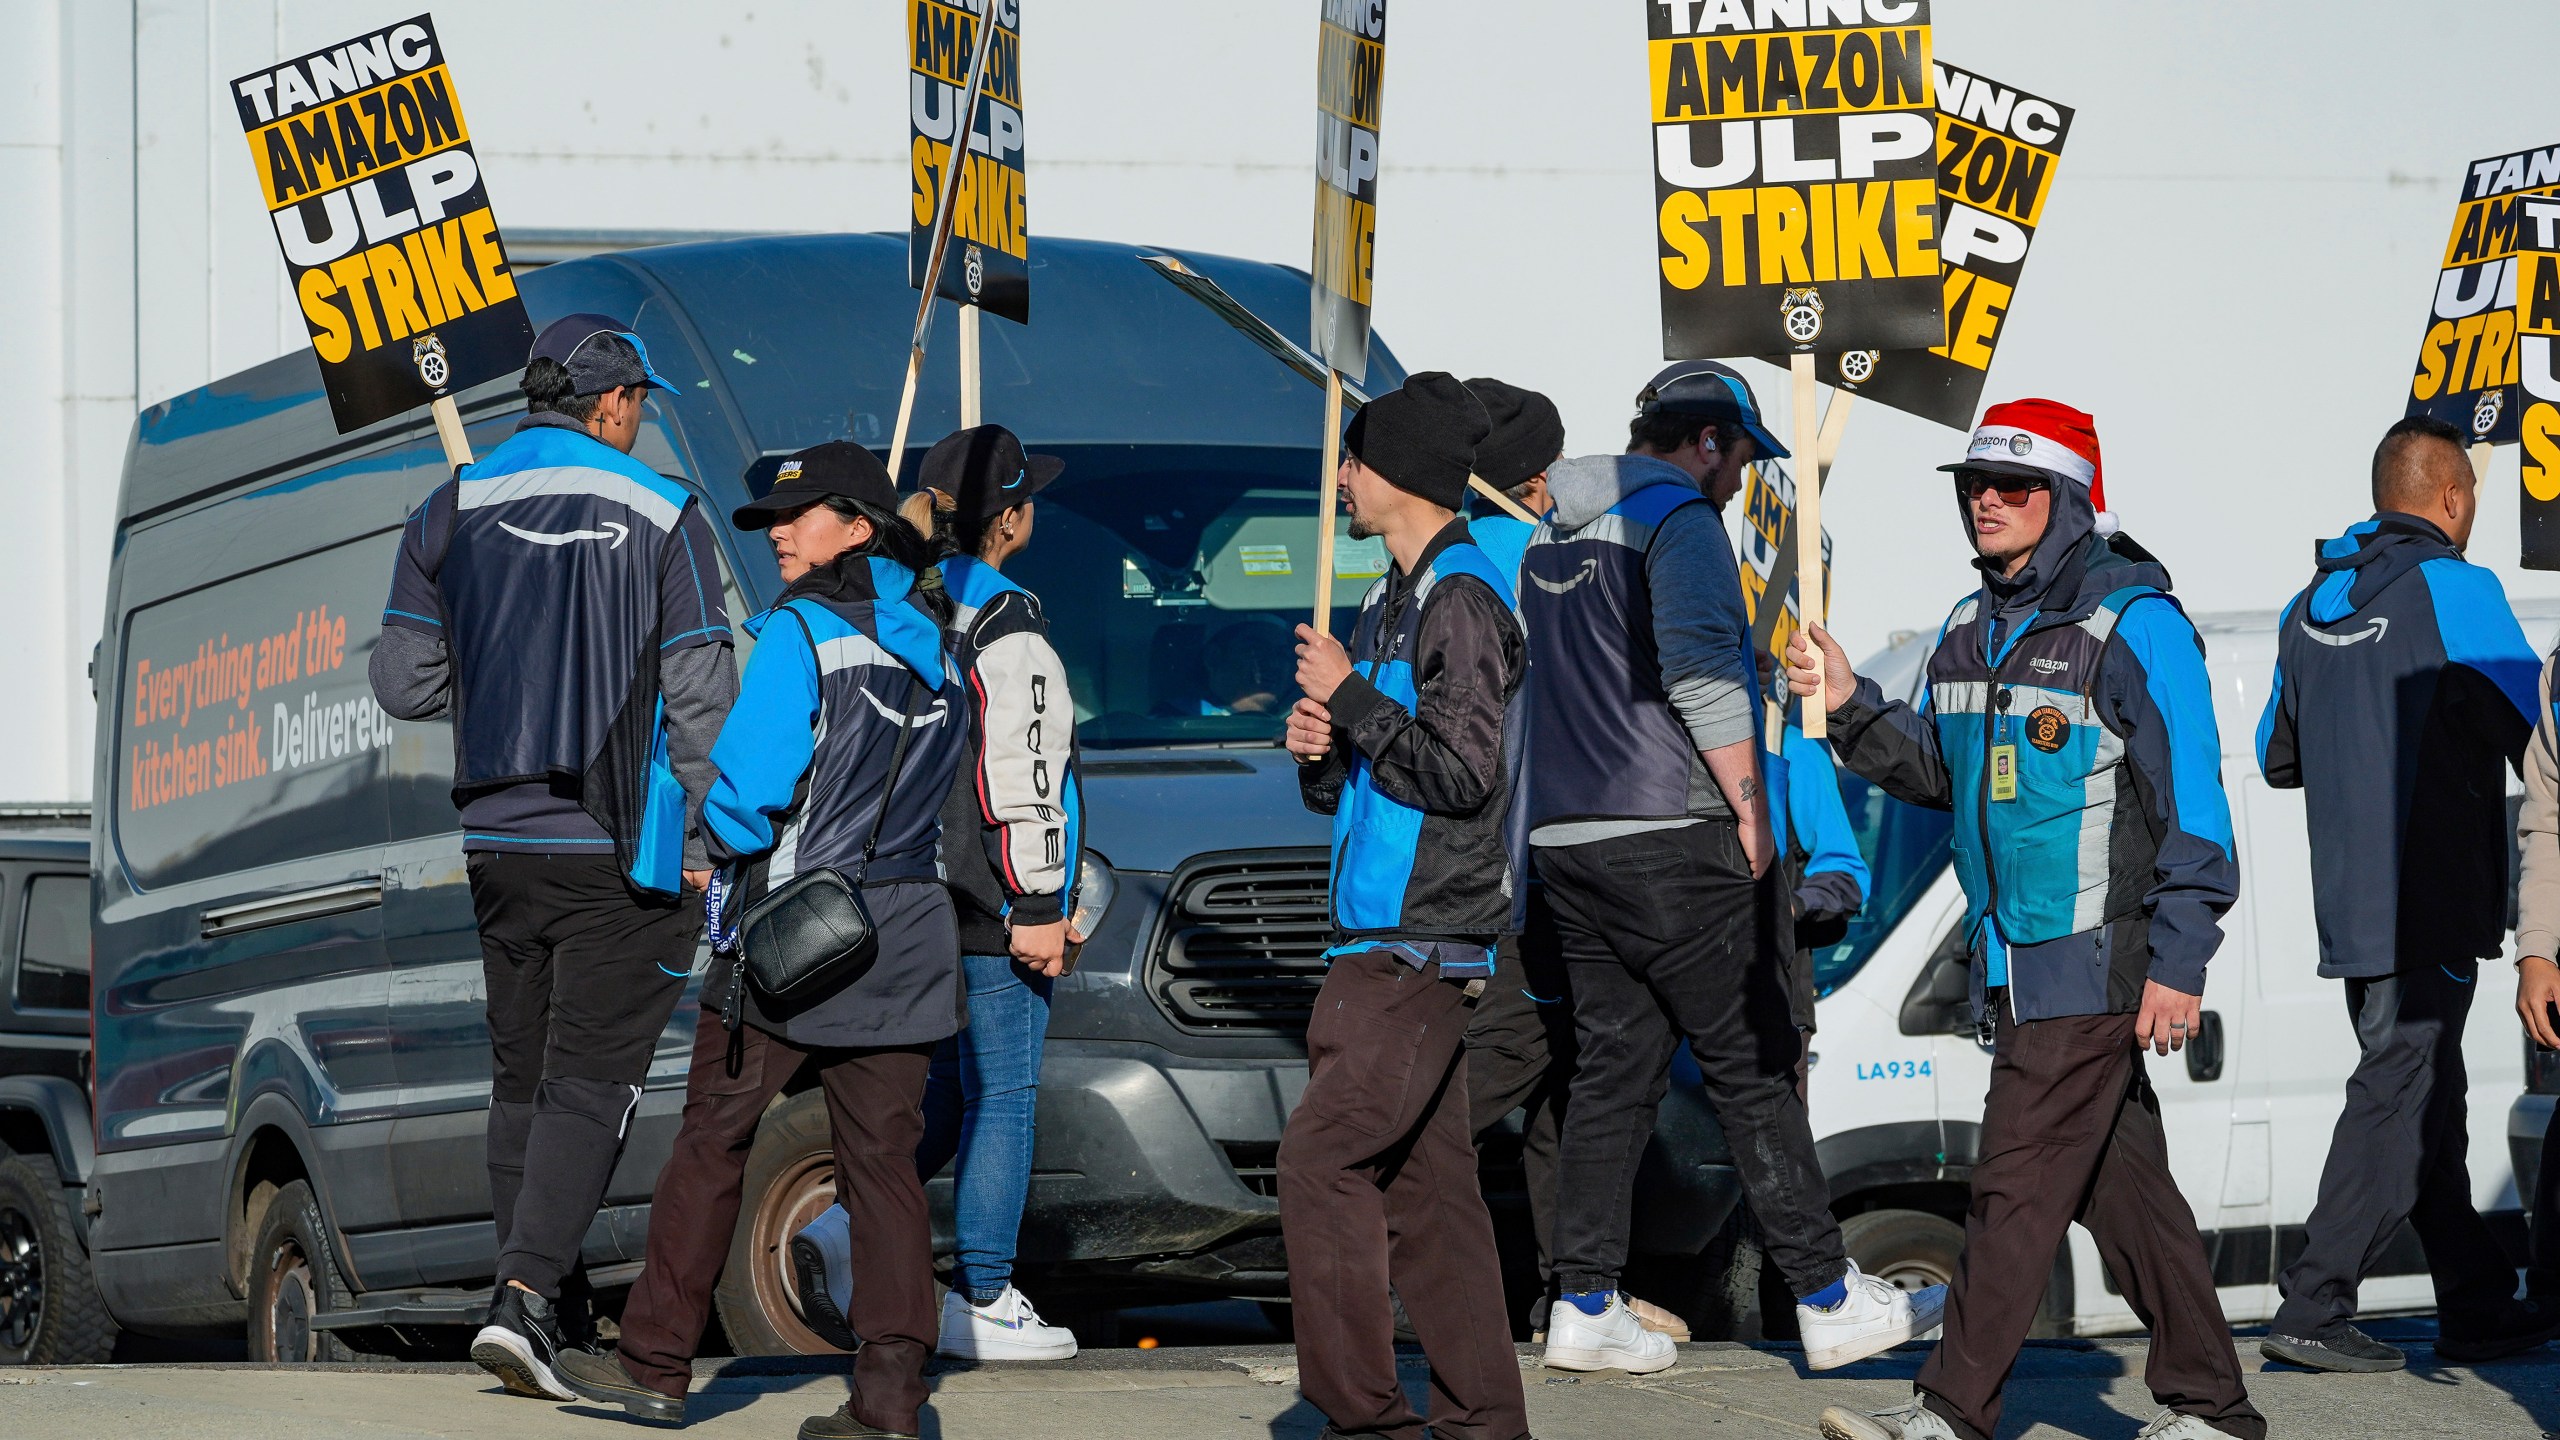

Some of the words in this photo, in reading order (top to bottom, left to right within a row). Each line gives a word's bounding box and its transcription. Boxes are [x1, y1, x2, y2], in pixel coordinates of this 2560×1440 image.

[238, 23, 432, 123] TANNC
[915, 1, 1019, 105] AMAON
[1319, 27, 1382, 127] AMAZON
[1665, 30, 1923, 118] AMAZON
[1933, 64, 2061, 145] NNC
[264, 69, 461, 204] AMAZON
[1316, 110, 1378, 195] ULP
[1656, 112, 1934, 188] ULP
[1936, 118, 2050, 221] ZON
[273, 149, 478, 267] ULP
[912, 135, 1027, 261] STRIKE
[1312, 179, 1376, 308] STRIKE
[1659, 178, 1940, 290] STRIKE
[298, 206, 518, 364] STRIKE
[134, 632, 254, 729] Everything
[256, 610, 303, 691] and
[305, 604, 346, 677] the
[2029, 657, 2069, 673] amazon
[131, 732, 211, 812] kitchen
[214, 709, 267, 789] sink.
[272, 690, 393, 772] Delivered.
[710, 868, 722, 936] TEAMSTERS
[1857, 1060, 1932, 1081] LA934
